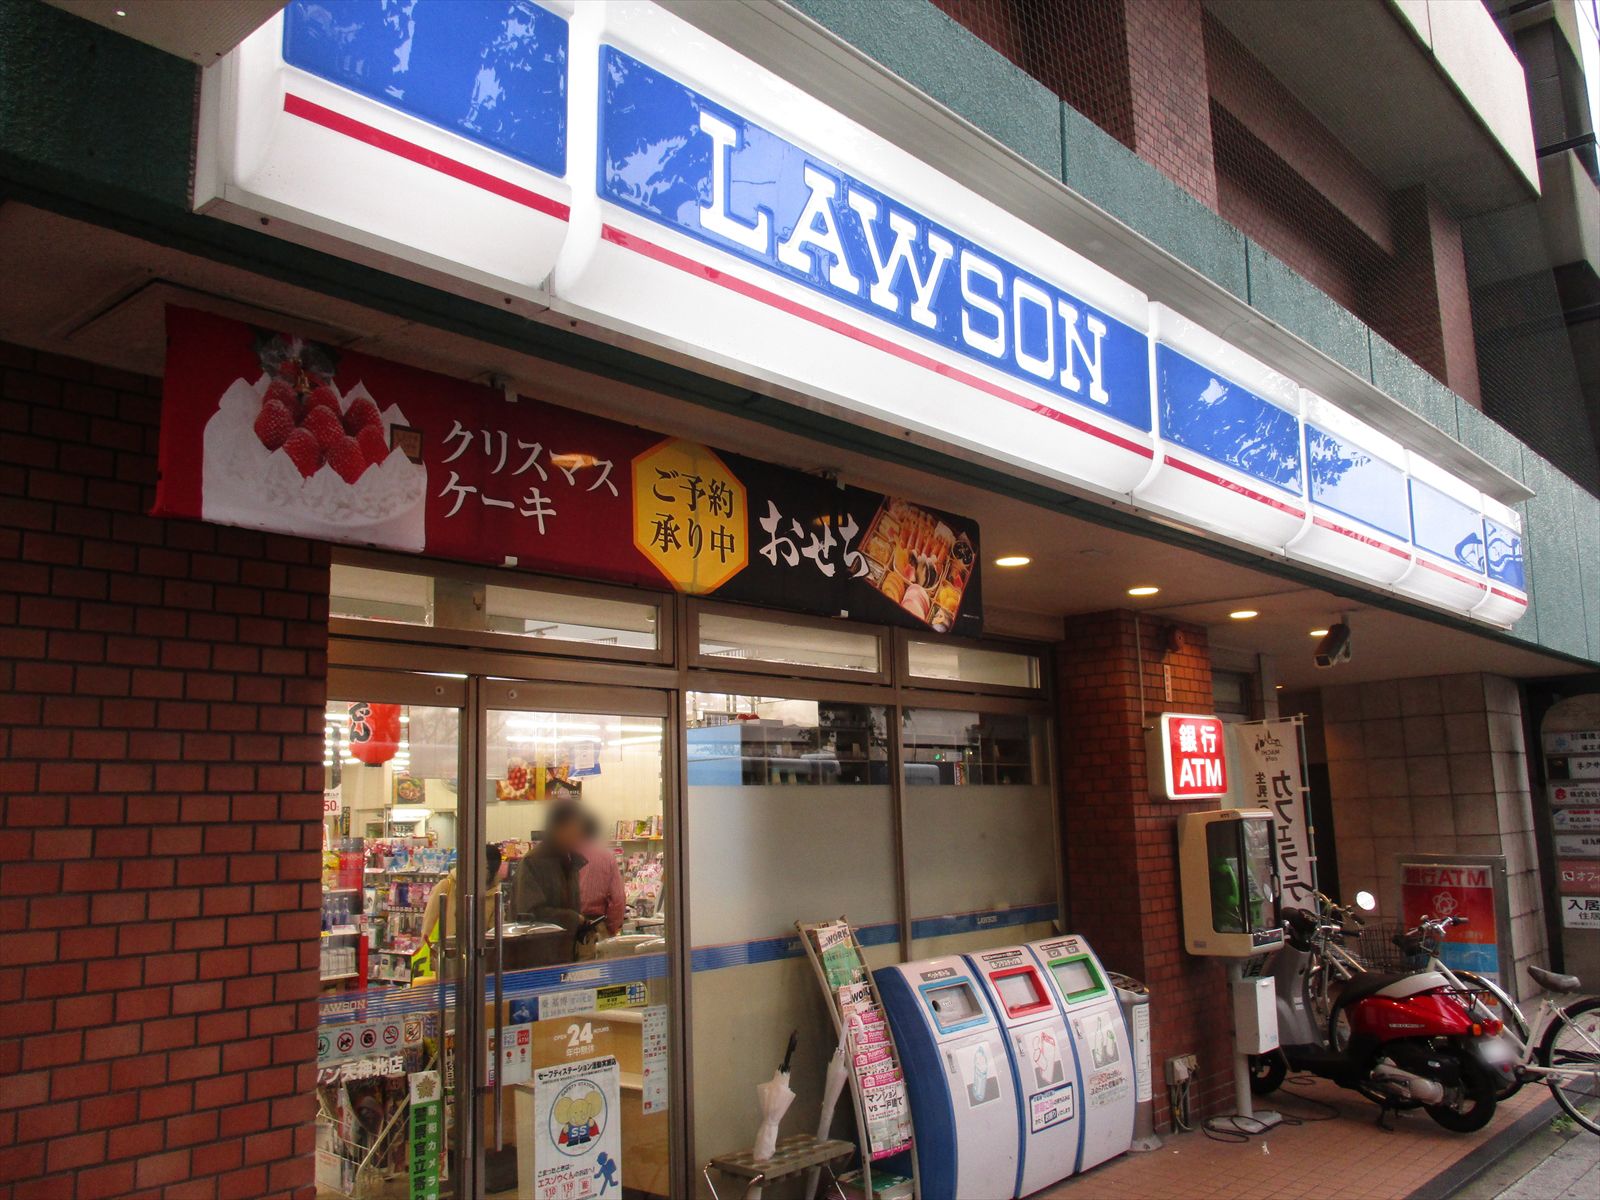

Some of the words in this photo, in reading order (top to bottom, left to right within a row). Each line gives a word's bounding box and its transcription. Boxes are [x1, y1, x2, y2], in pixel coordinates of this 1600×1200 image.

[699, 109, 1109, 405] LAWSON
[441, 420, 619, 497] クリスマス
[438, 470, 557, 535] ケーキ
[652, 467, 734, 518] ご予約
[650, 511, 736, 563] 承り中
[759, 500, 869, 580] おせち
[1178, 724, 1217, 753] 銀行
[1180, 758, 1222, 788] ATM
[567, 1022, 594, 1047] 24
[867, 1089, 897, 1104] マンション
[571, 1125, 587, 1138] SS
